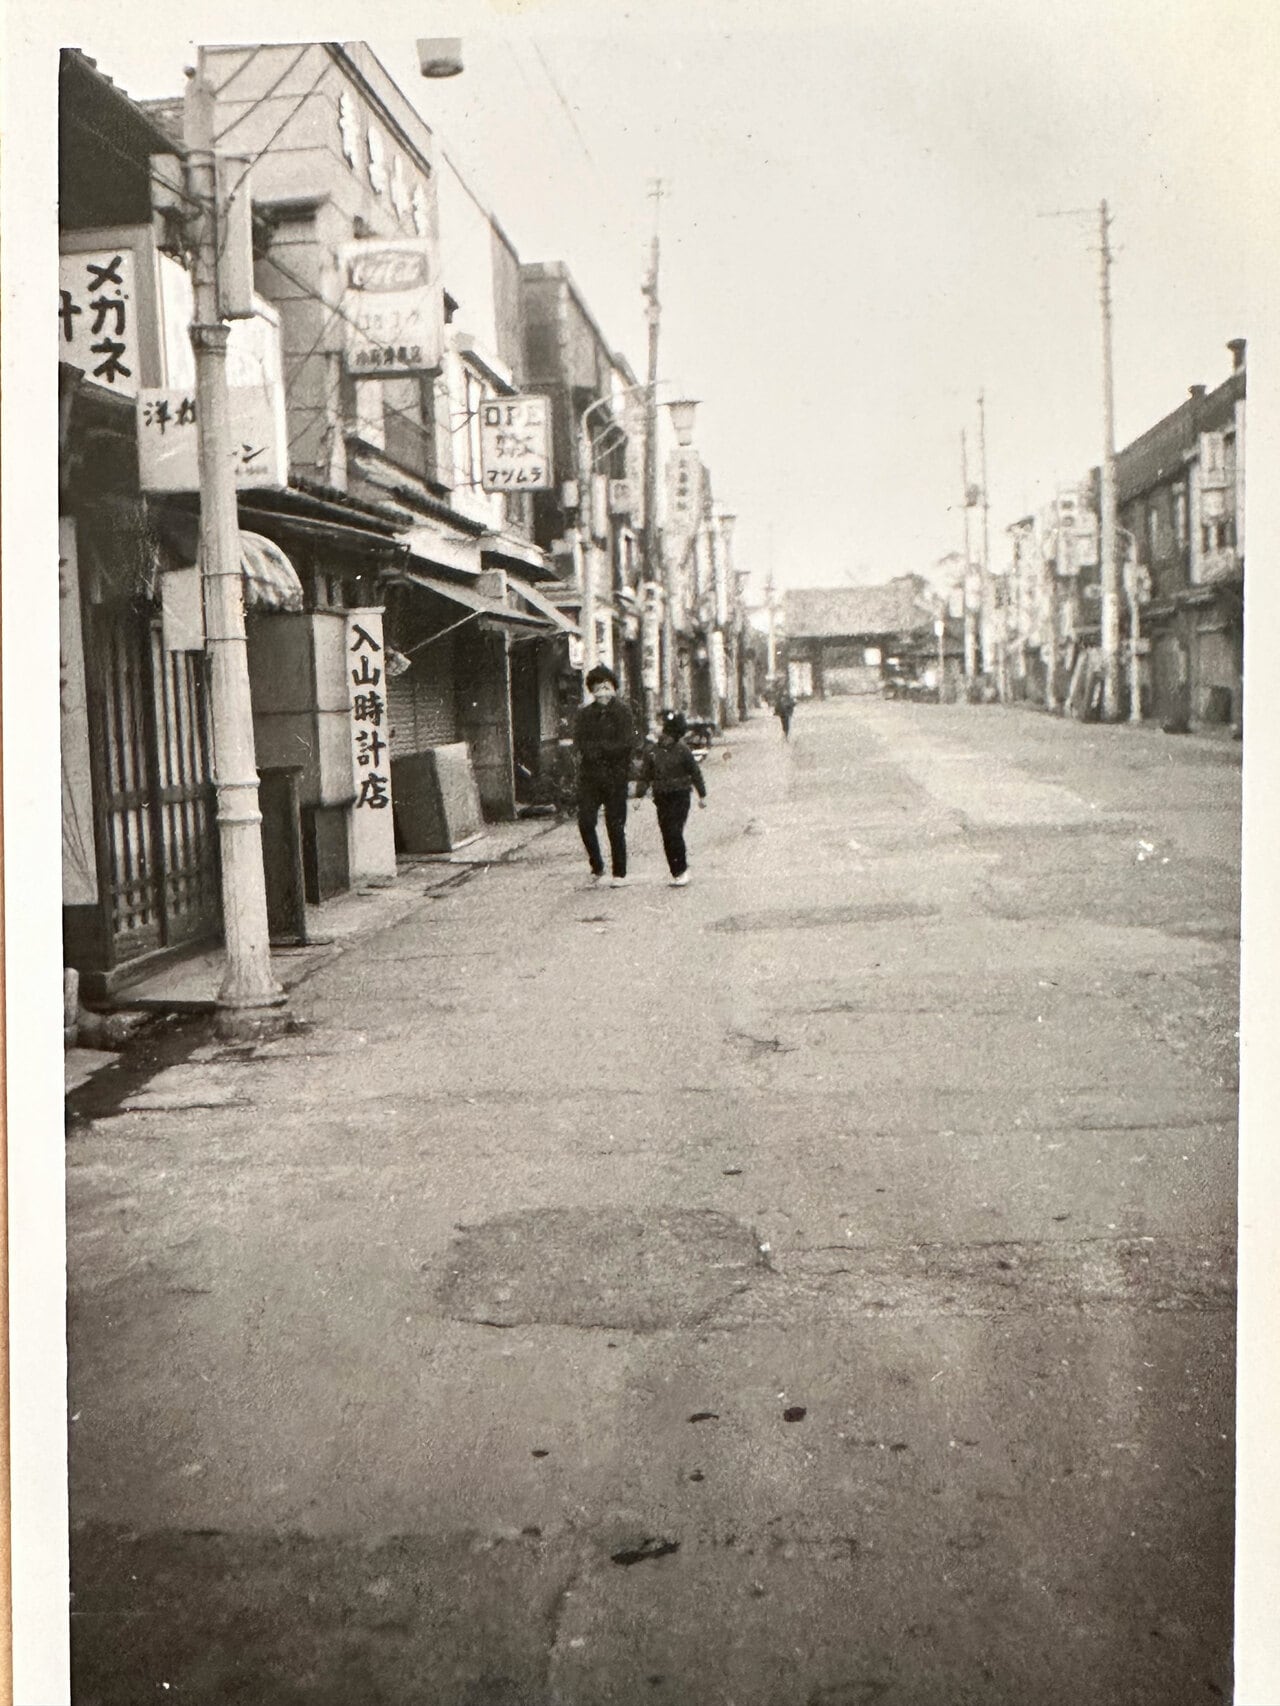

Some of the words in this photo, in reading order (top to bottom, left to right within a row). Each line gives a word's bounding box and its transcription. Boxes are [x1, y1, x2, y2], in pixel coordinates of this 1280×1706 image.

[86, 255, 132, 383] メガネ
[350, 624, 389, 809] 入山時計店
